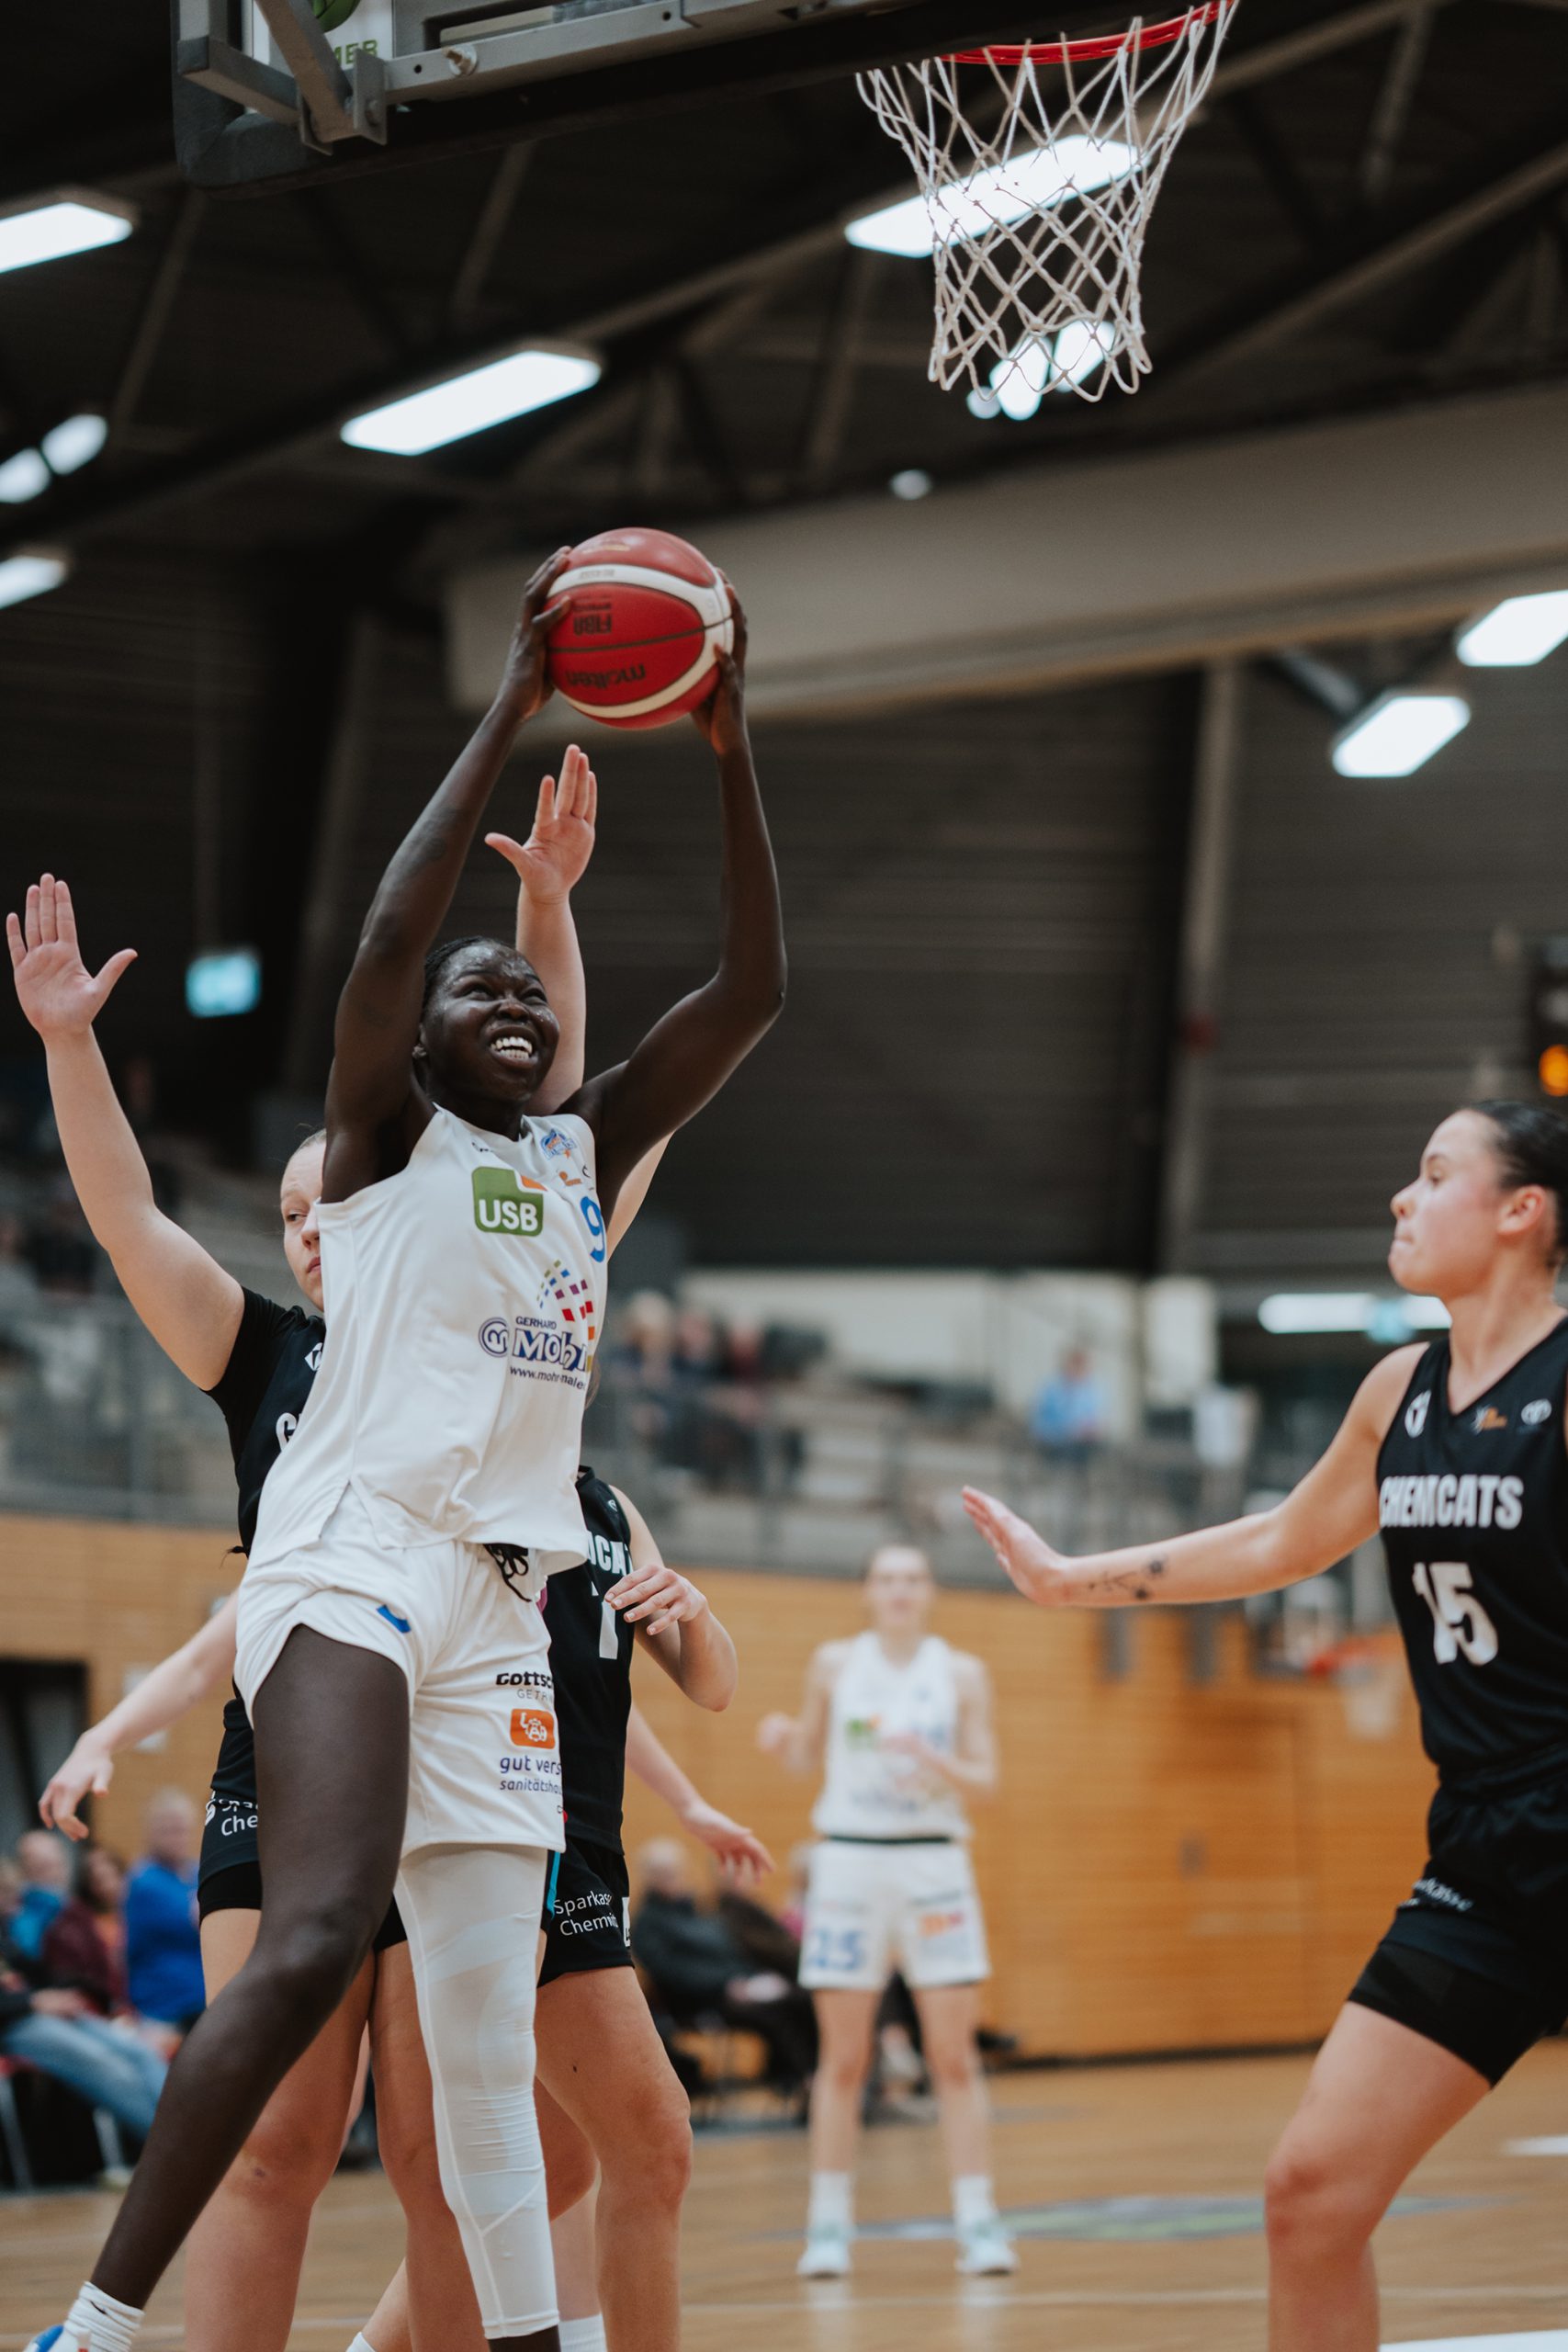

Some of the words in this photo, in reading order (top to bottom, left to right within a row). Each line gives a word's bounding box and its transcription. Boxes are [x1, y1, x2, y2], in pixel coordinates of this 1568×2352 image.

[479, 1199, 538, 1232] USB
[581, 1196, 605, 1262] 9
[1412, 1562, 1498, 1665] 15
[500, 1756, 531, 1774] gut
